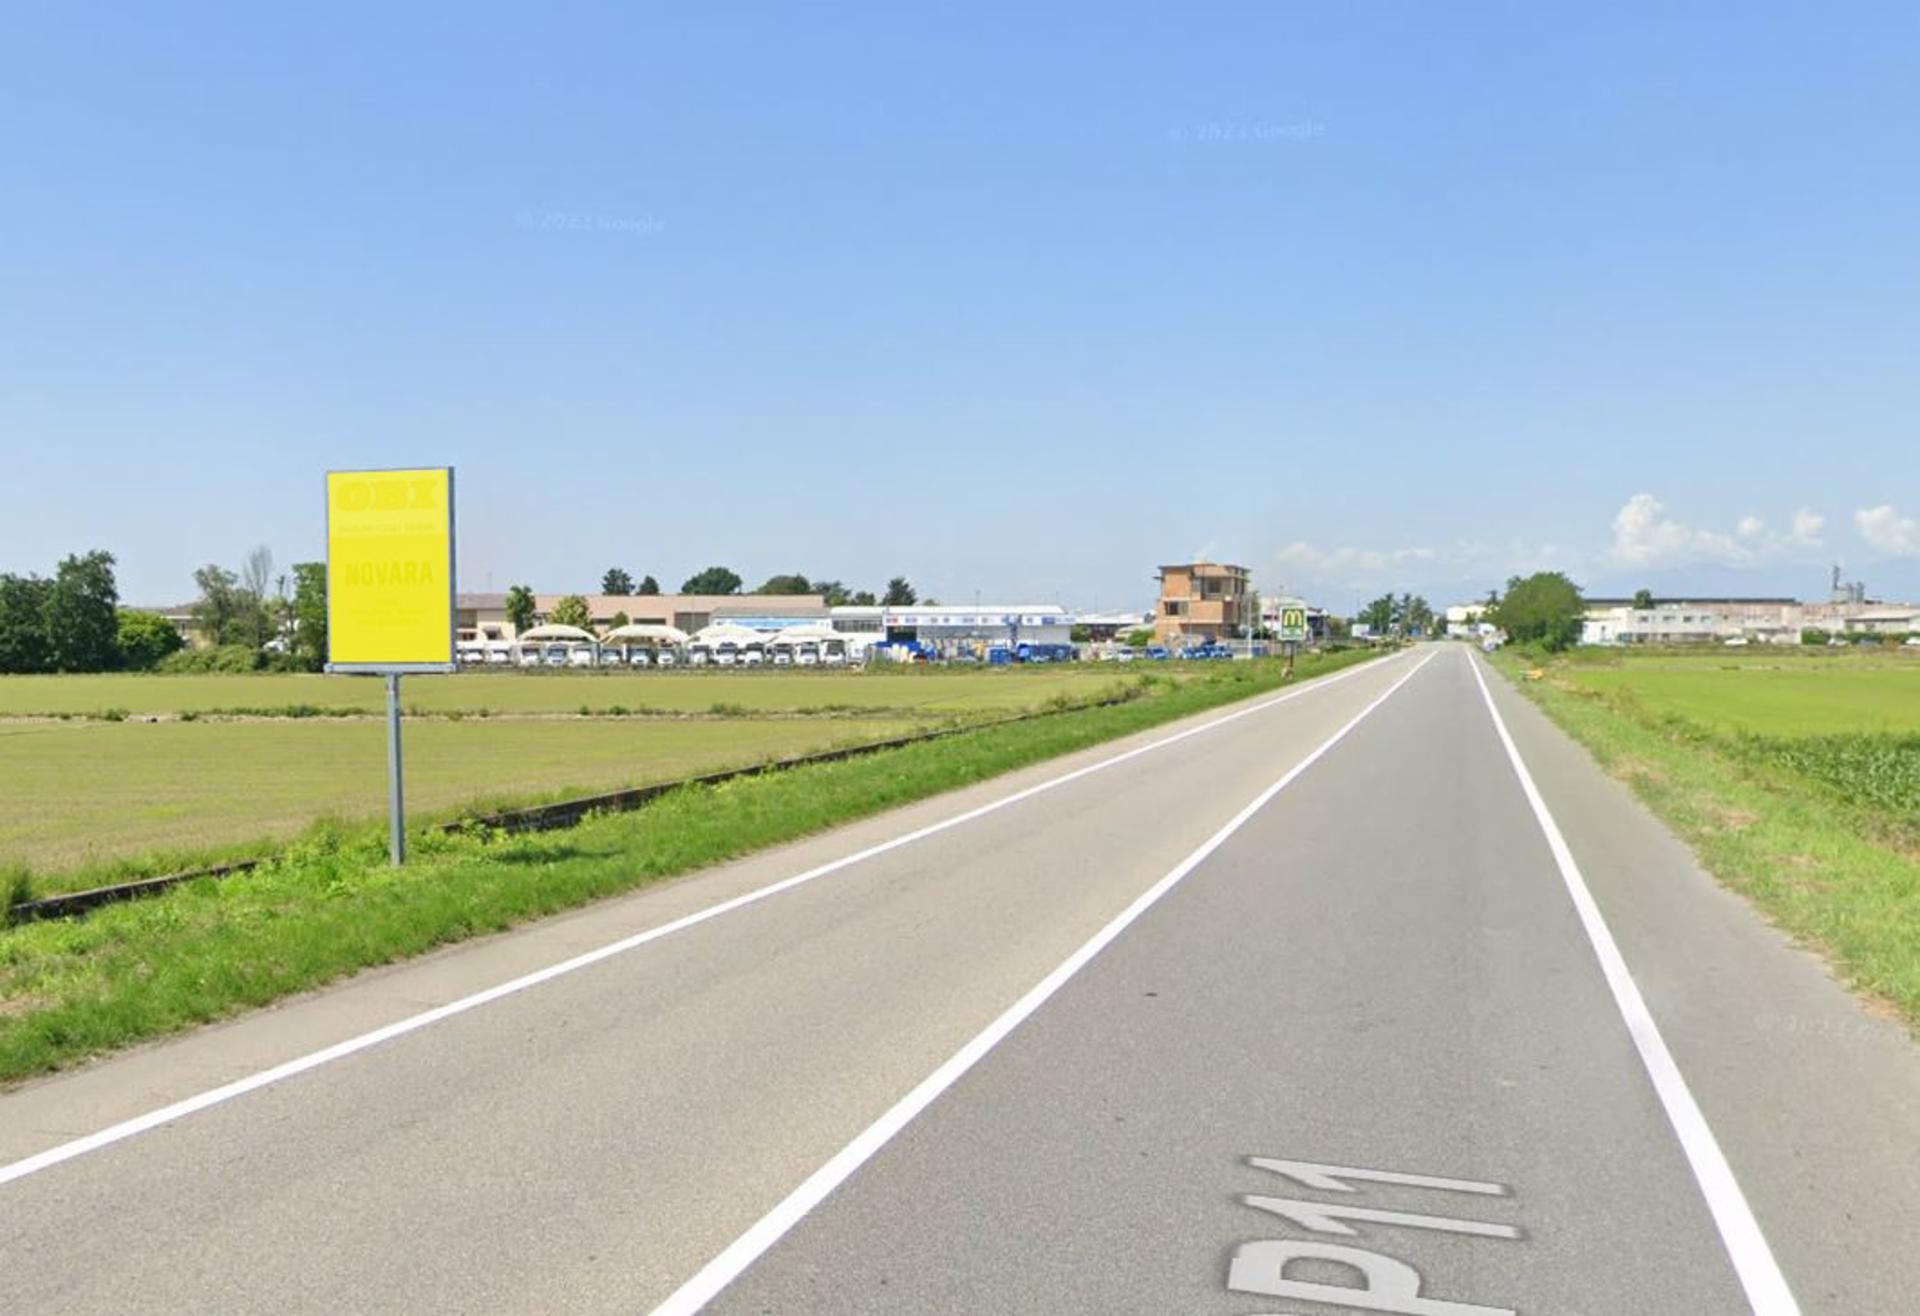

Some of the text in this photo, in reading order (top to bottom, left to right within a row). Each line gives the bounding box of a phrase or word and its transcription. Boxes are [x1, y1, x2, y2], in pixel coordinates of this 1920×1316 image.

[336, 479, 438, 512] OBI
[345, 560, 434, 586] NOVARA
[1228, 1155, 1522, 1316] P11
